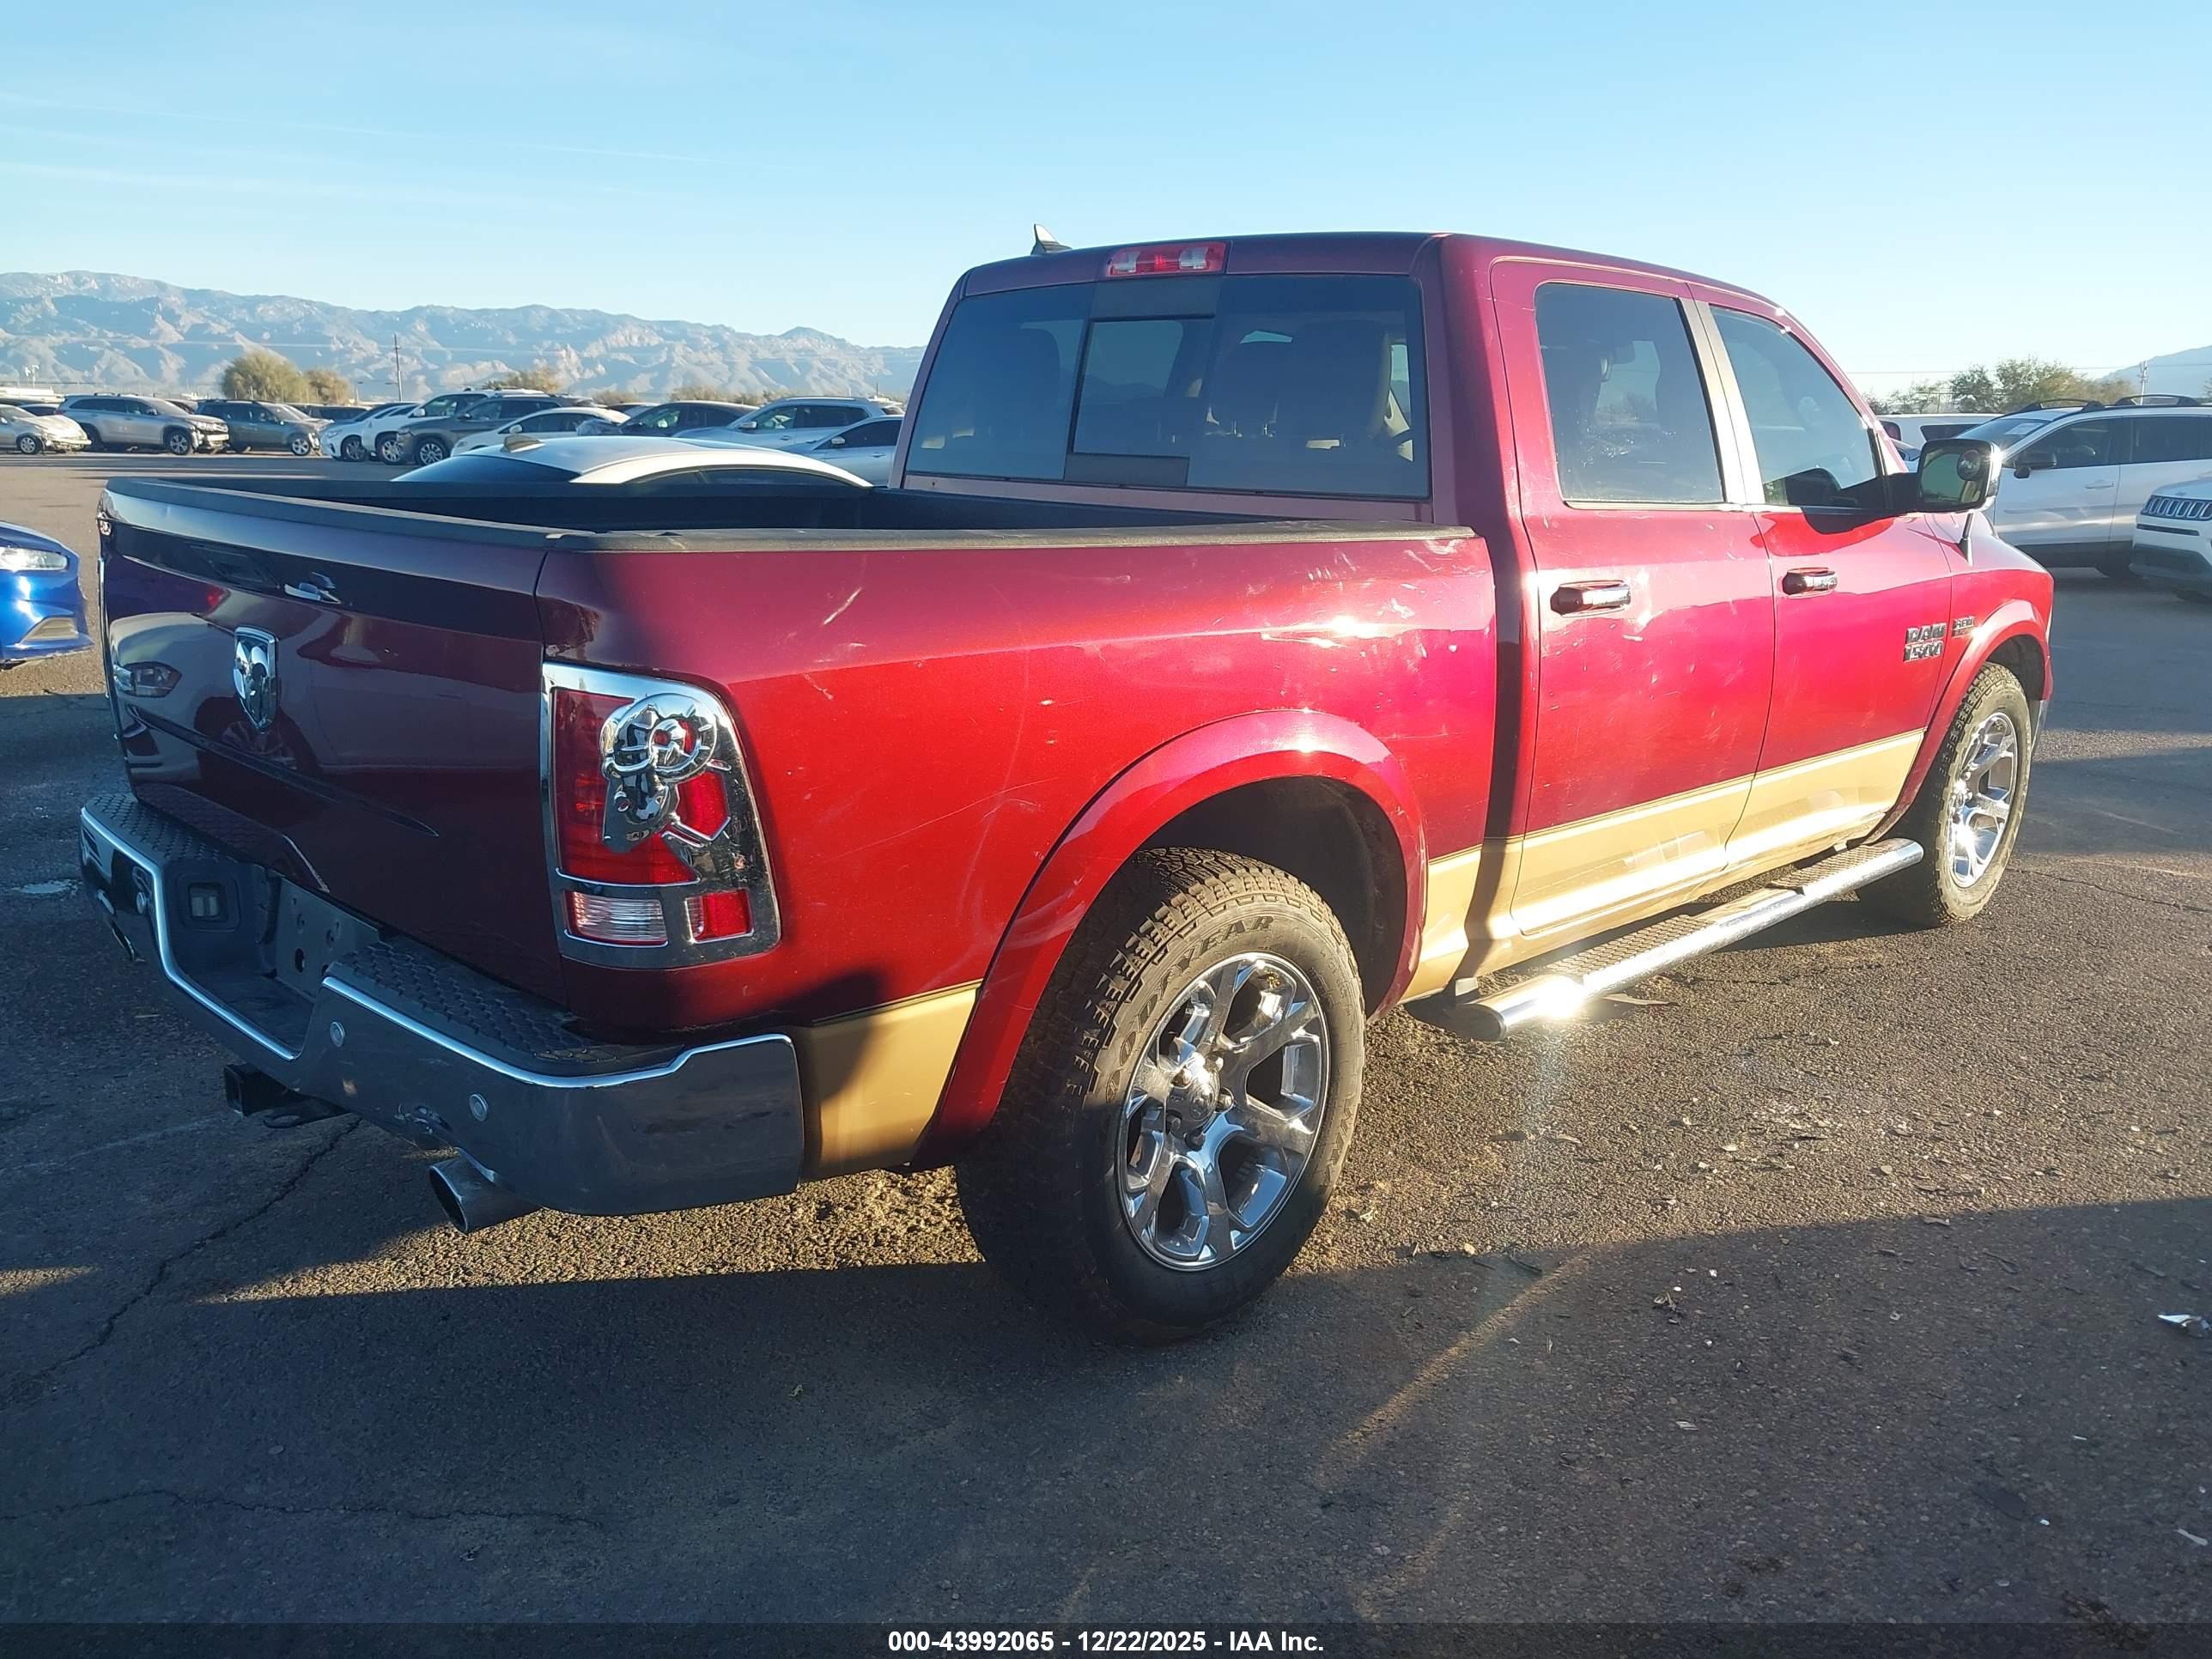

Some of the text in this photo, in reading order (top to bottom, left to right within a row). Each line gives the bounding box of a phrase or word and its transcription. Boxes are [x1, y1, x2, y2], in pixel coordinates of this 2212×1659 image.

[1905, 623, 1947, 643] RAM
[1903, 641, 1944, 662] 1500
[1106, 916, 1274, 1103] GOODYEAR
